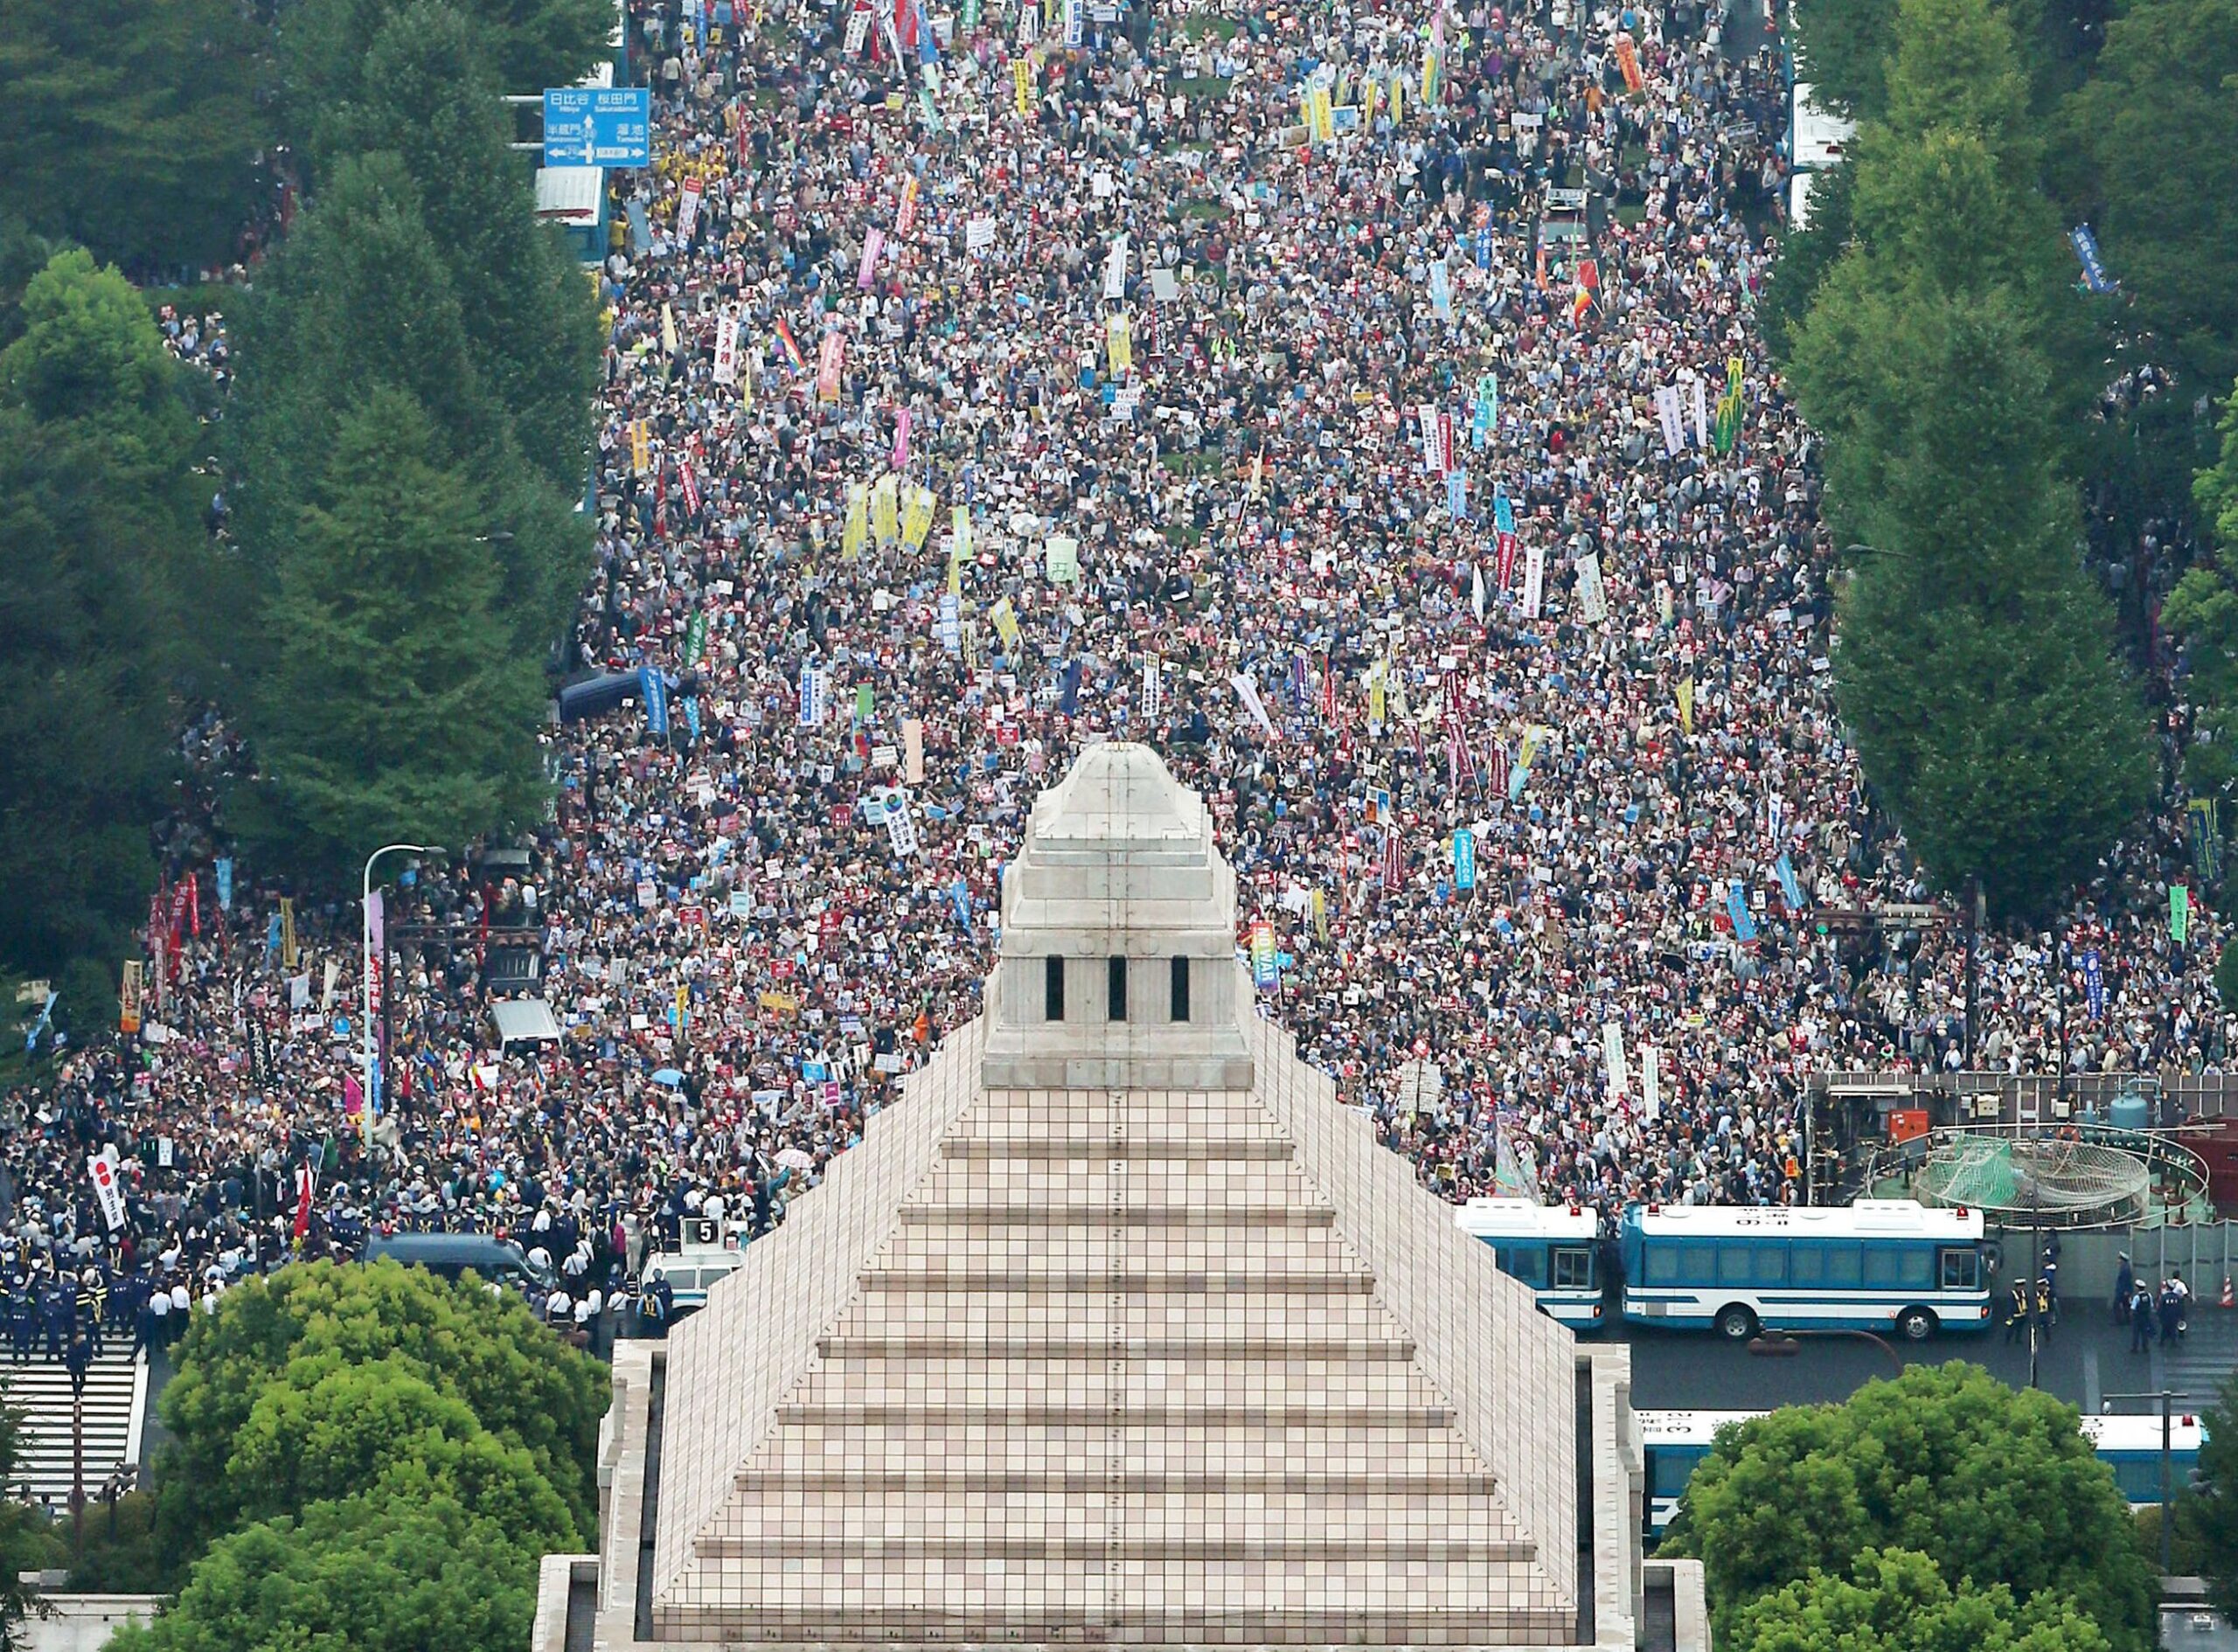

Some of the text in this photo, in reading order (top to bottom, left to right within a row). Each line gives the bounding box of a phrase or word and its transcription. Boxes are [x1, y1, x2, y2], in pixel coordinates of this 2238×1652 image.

[551, 93, 637, 105] 日比谷 桜田門
[547, 123, 581, 135] 半蔵門
[1256, 927, 1275, 982] NO WAR
[699, 1221, 712, 1242] 5
